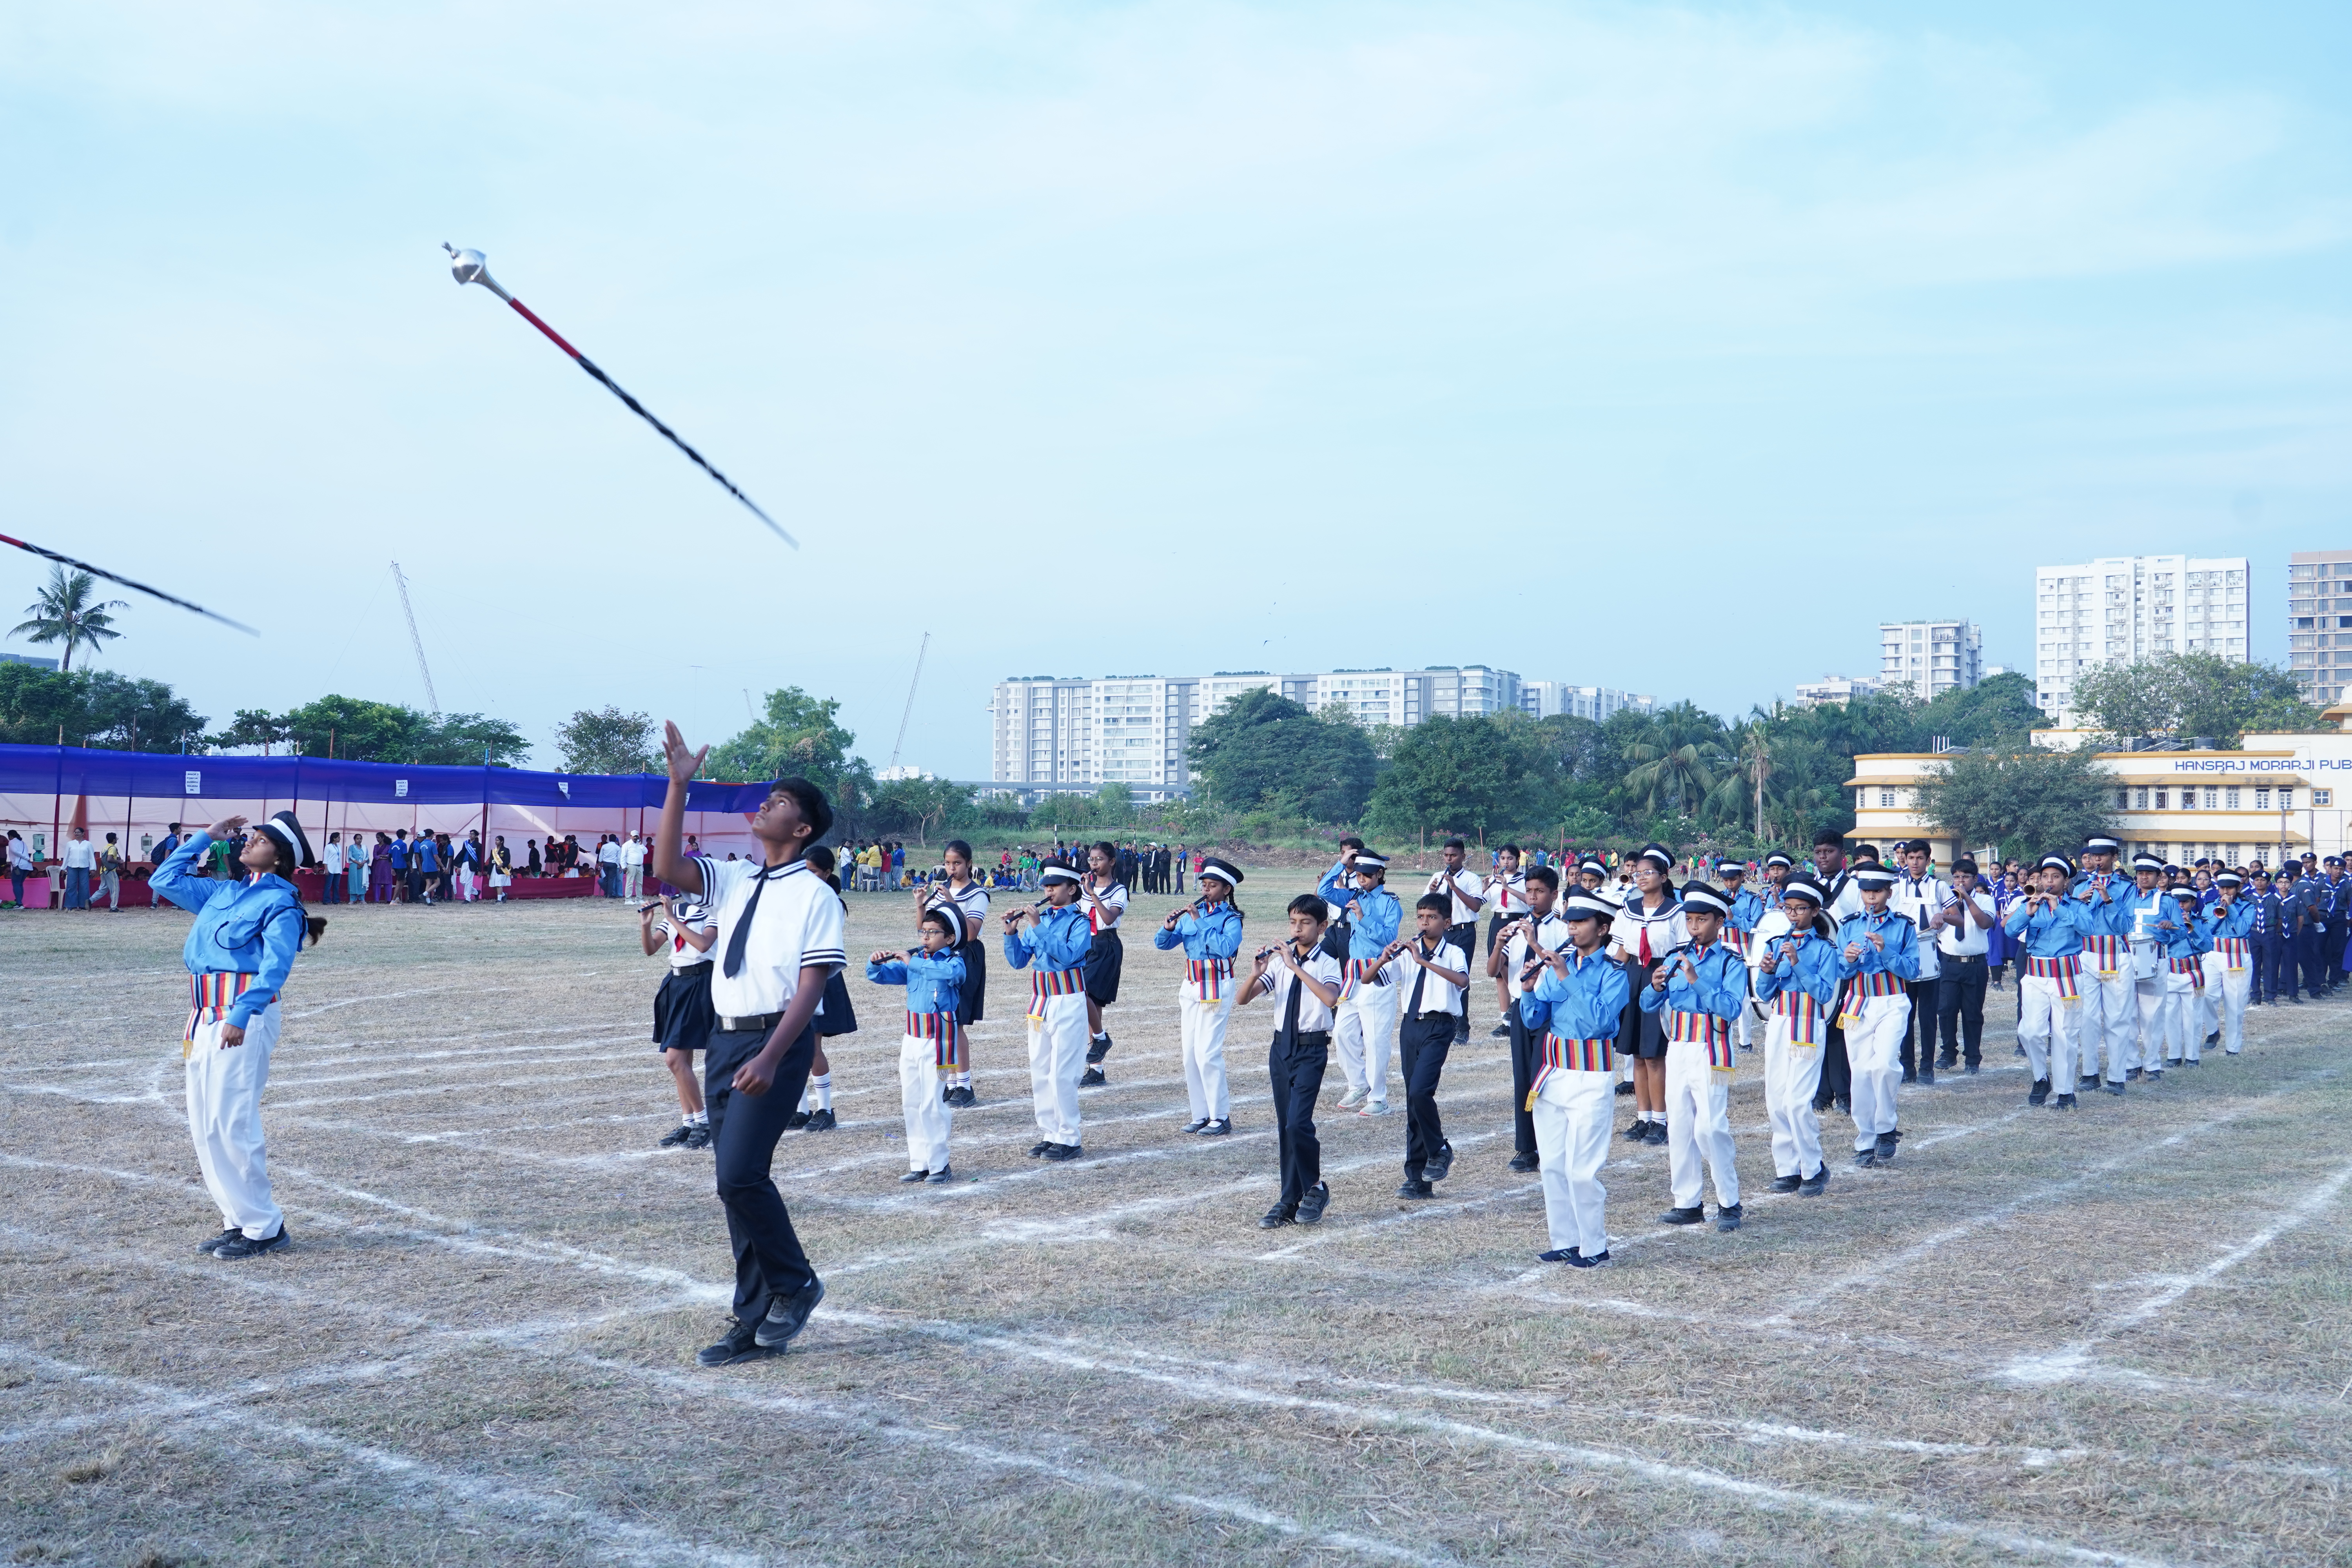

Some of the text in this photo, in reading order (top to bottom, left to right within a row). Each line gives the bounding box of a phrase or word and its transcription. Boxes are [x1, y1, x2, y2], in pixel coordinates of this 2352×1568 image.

[2175, 760, 2352, 771] HANSRAJ MORARJI PUB
